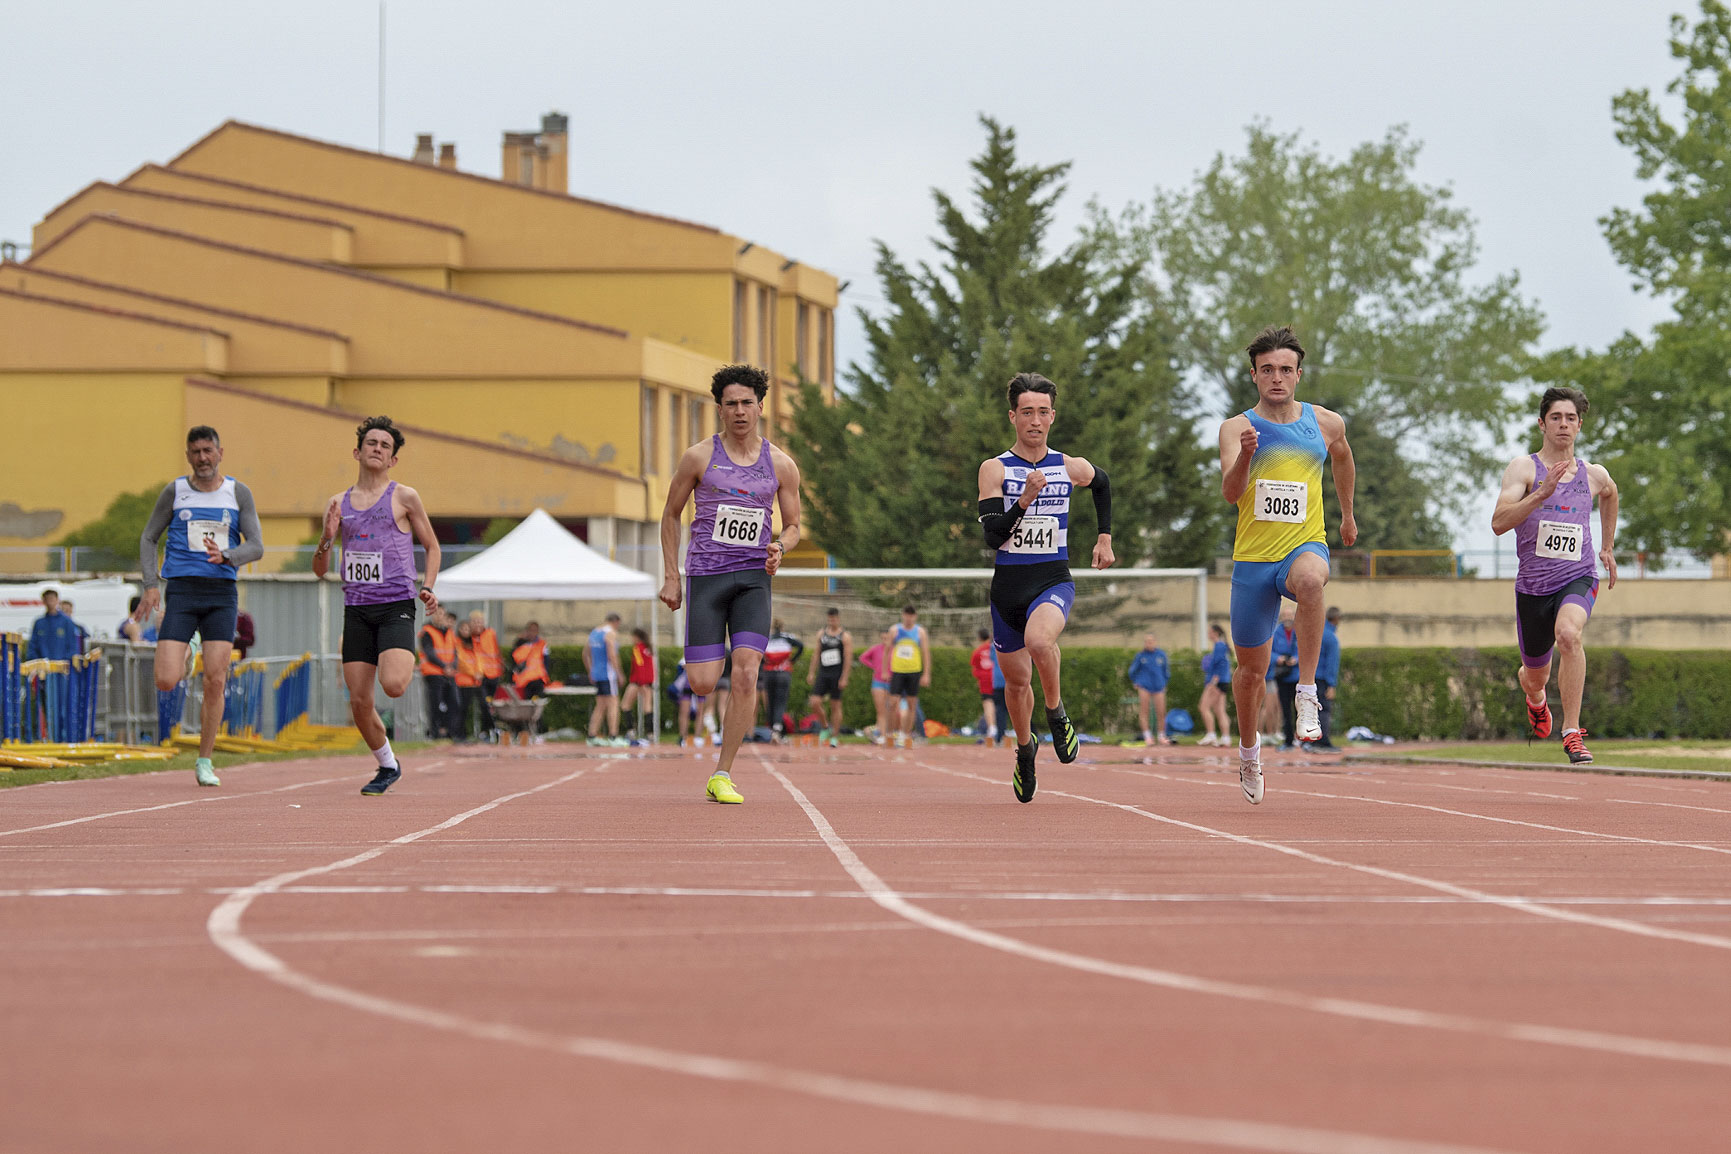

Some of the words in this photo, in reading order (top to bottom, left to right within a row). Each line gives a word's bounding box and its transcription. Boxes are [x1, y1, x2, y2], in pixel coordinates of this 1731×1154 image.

[1006, 481, 1069, 496] RING
[1264, 496, 1299, 516] 3083
[718, 517, 758, 542] 1668
[1013, 528, 1053, 548] 5441
[1545, 534, 1577, 553] 4978
[347, 562, 380, 582] 1804
